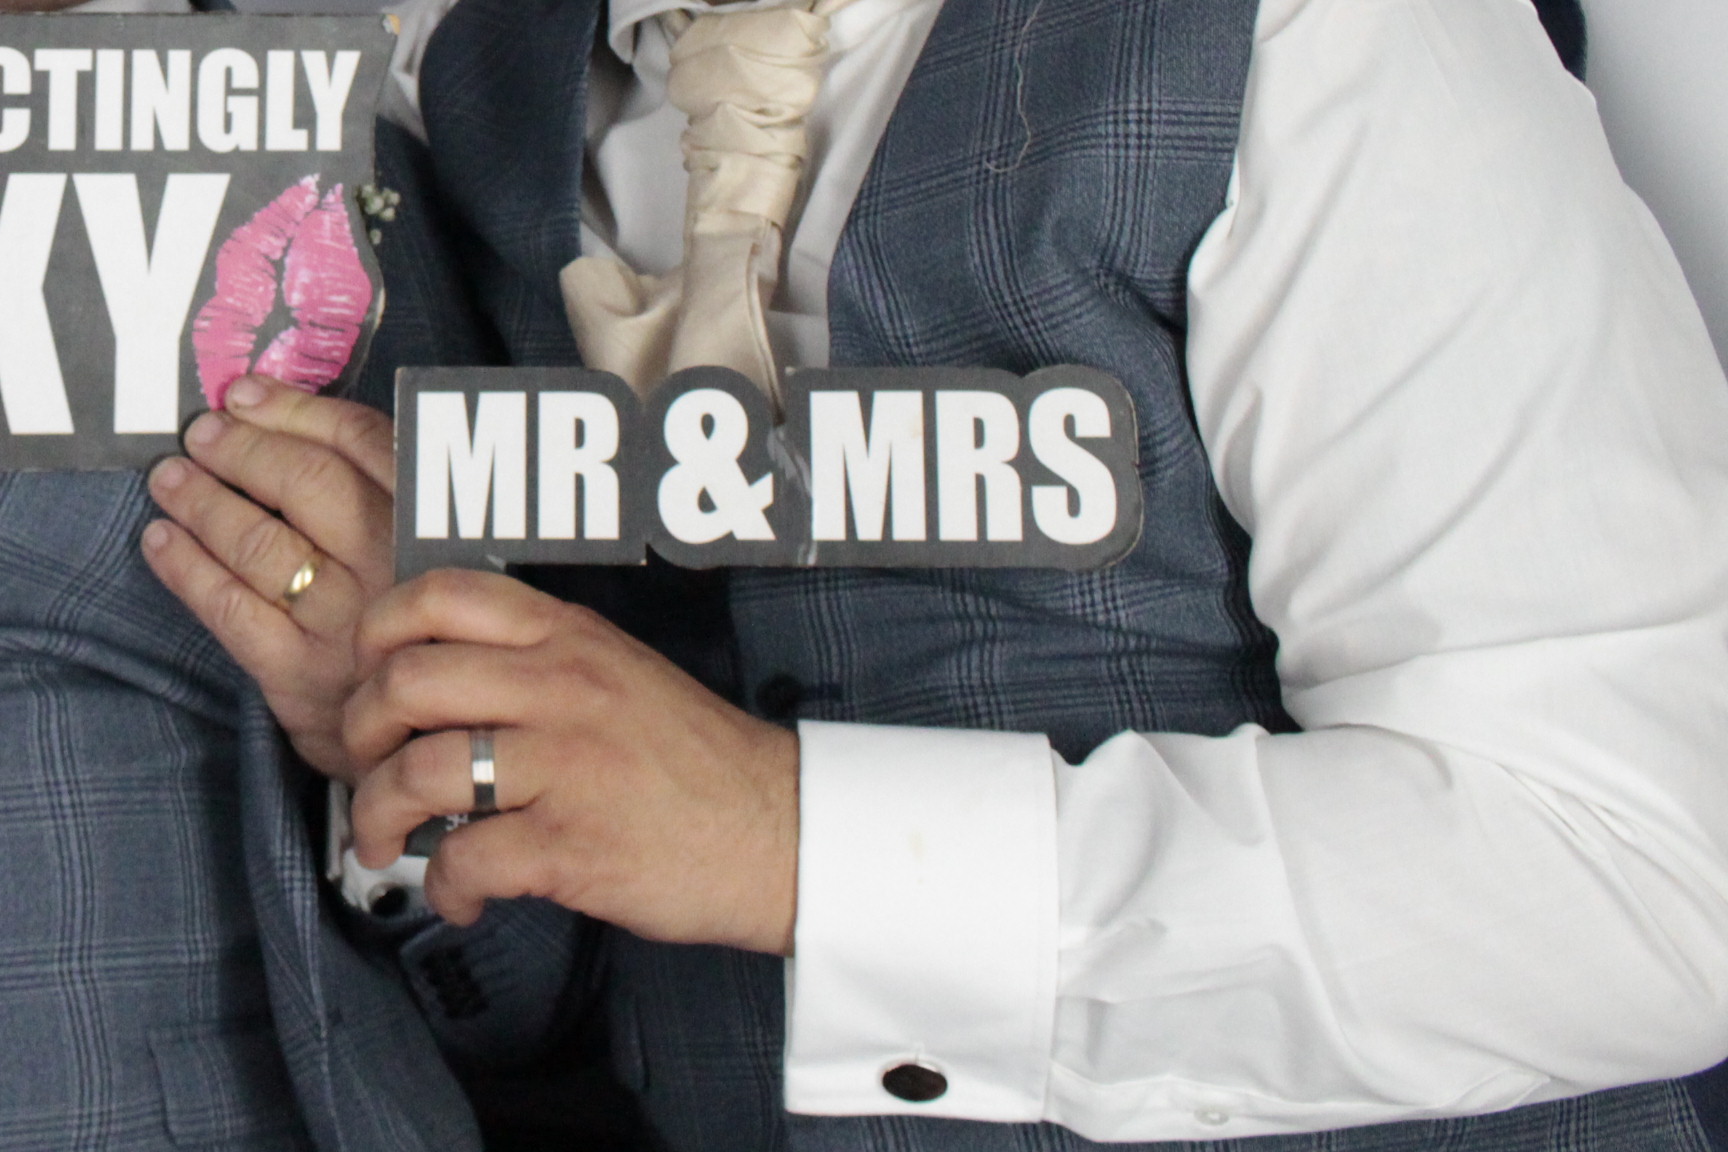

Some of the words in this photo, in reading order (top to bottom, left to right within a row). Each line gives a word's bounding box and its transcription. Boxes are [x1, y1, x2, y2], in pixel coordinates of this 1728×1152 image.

[415, 391, 620, 540] MR
[657, 388, 777, 544] &
[809, 387, 1117, 545] MRS
